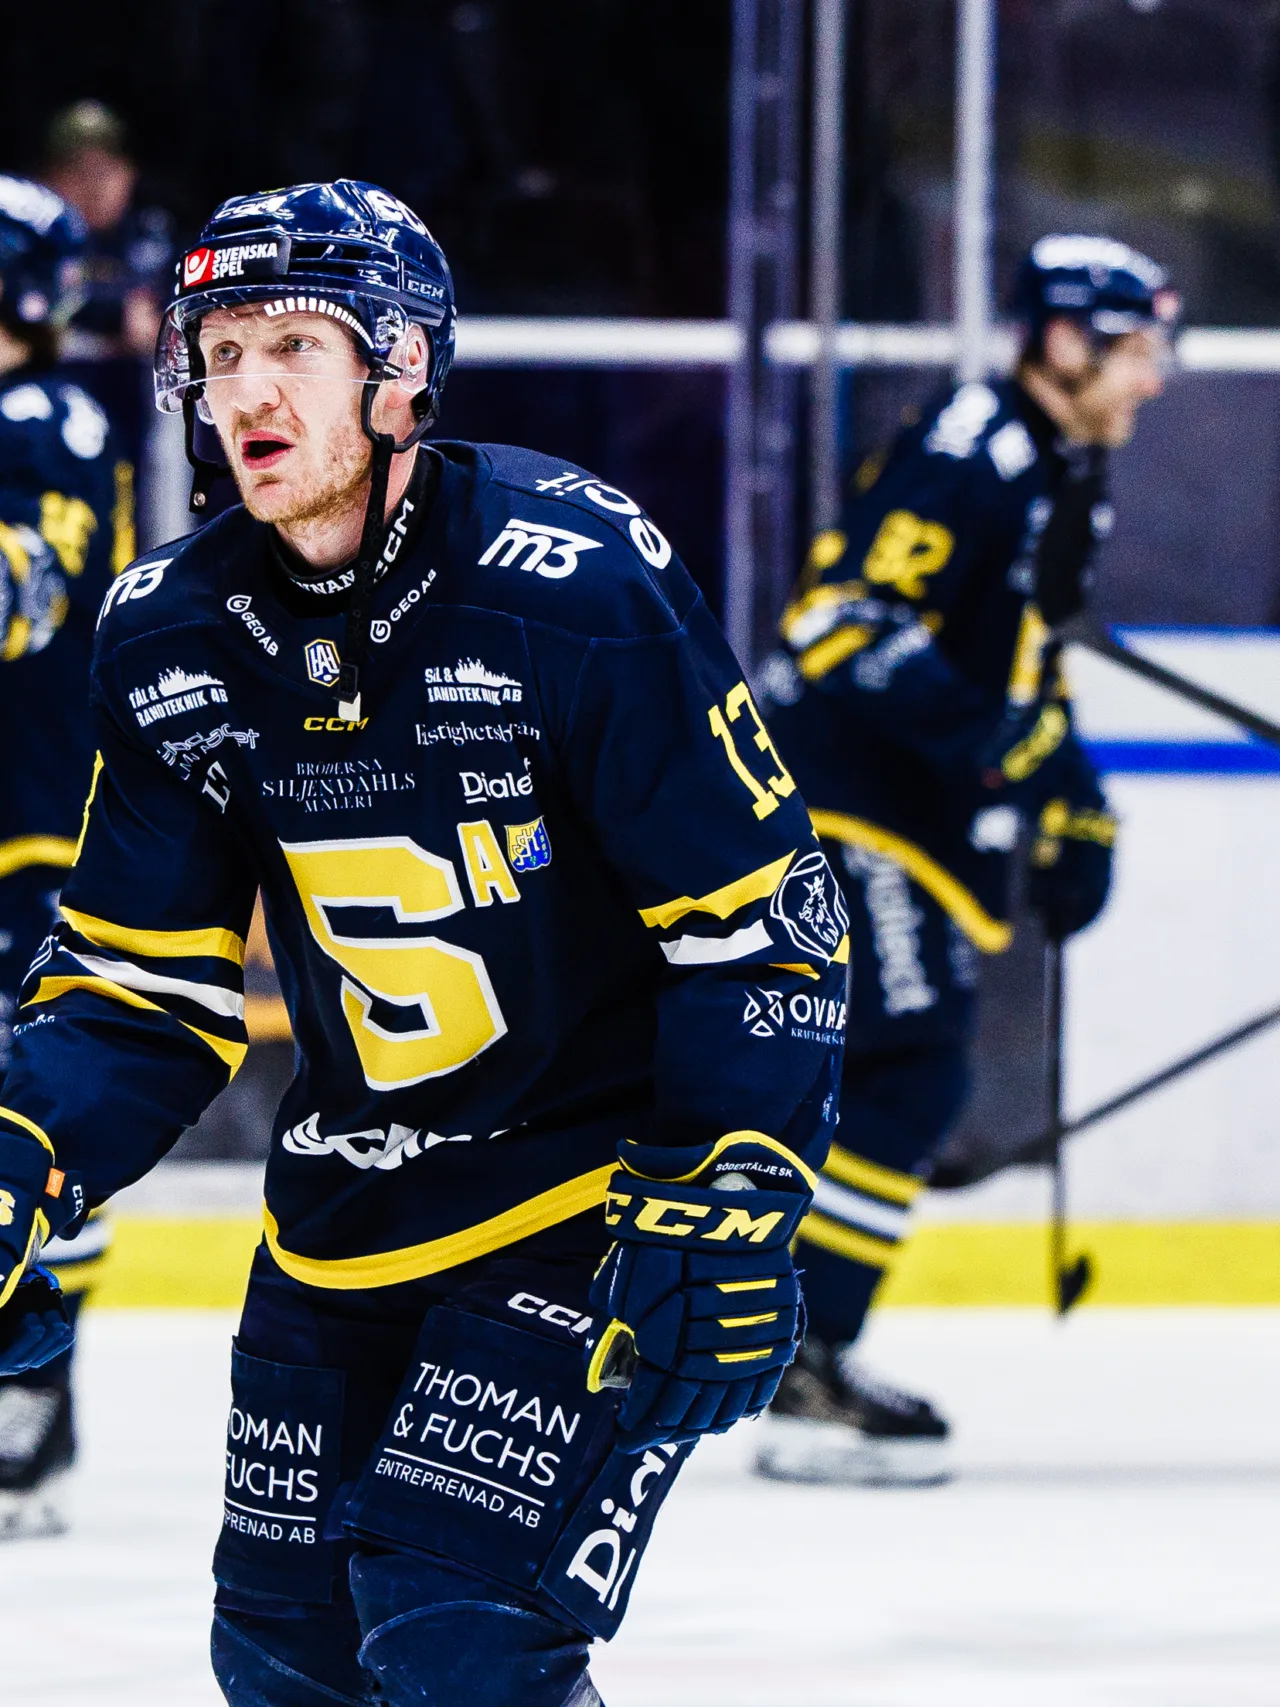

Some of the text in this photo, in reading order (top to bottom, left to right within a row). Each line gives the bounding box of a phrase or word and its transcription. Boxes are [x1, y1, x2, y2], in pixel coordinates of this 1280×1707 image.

[211, 260, 245, 280] SPEL
[213, 242, 278, 263] SVENSKA
[407, 280, 444, 299] CCM
[373, 498, 415, 583] CM
[390, 568, 437, 621] GEO AB
[241, 611, 279, 656] GEO AB
[148, 685, 159, 701] &
[210, 688, 229, 702] AB
[502, 687, 523, 702] AB
[303, 717, 369, 731] CCM
[708, 681, 797, 821] 13
[457, 820, 521, 908] A
[715, 1162, 793, 1178] SÖDERTÄLJE SK
[413, 1361, 581, 1444] THOMAN
[228, 1407, 322, 1457] OMAN
[393, 1402, 561, 1487] & FUCHS
[374, 1457, 541, 1528] ENTREPRENAD AB
[224, 1508, 317, 1545] PRENAD AB
